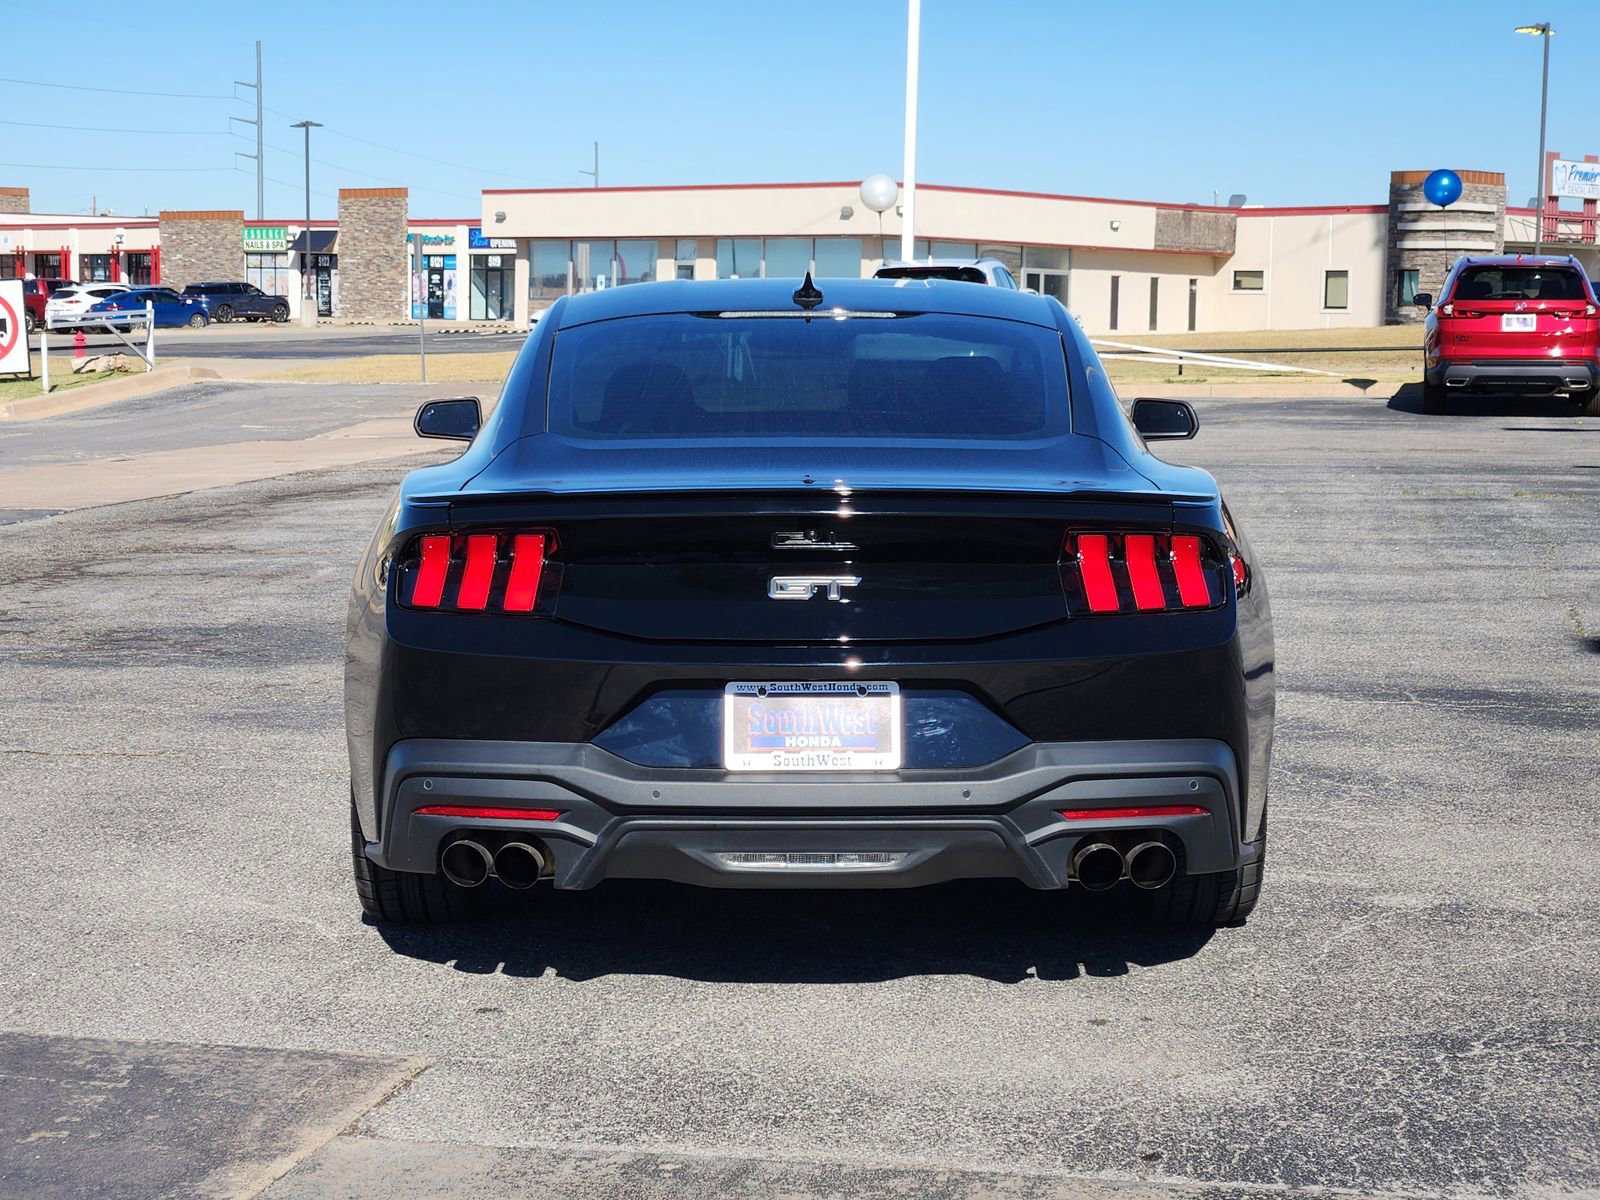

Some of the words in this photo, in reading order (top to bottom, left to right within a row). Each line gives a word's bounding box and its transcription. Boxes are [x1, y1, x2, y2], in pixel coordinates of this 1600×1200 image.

[1568, 165, 1600, 182] Premier
[244, 229, 285, 240] ESSENCE
[245, 241, 264, 249] NAILS
[265, 241, 270, 249] &
[271, 241, 284, 249] SPA
[318, 256, 330, 267] 5123
[429, 256, 443, 268] 5121
[487, 255, 501, 267] 5119
[768, 576, 862, 601] GT
[785, 736, 842, 748] HONDA
[773, 754, 852, 768] SouthWest
